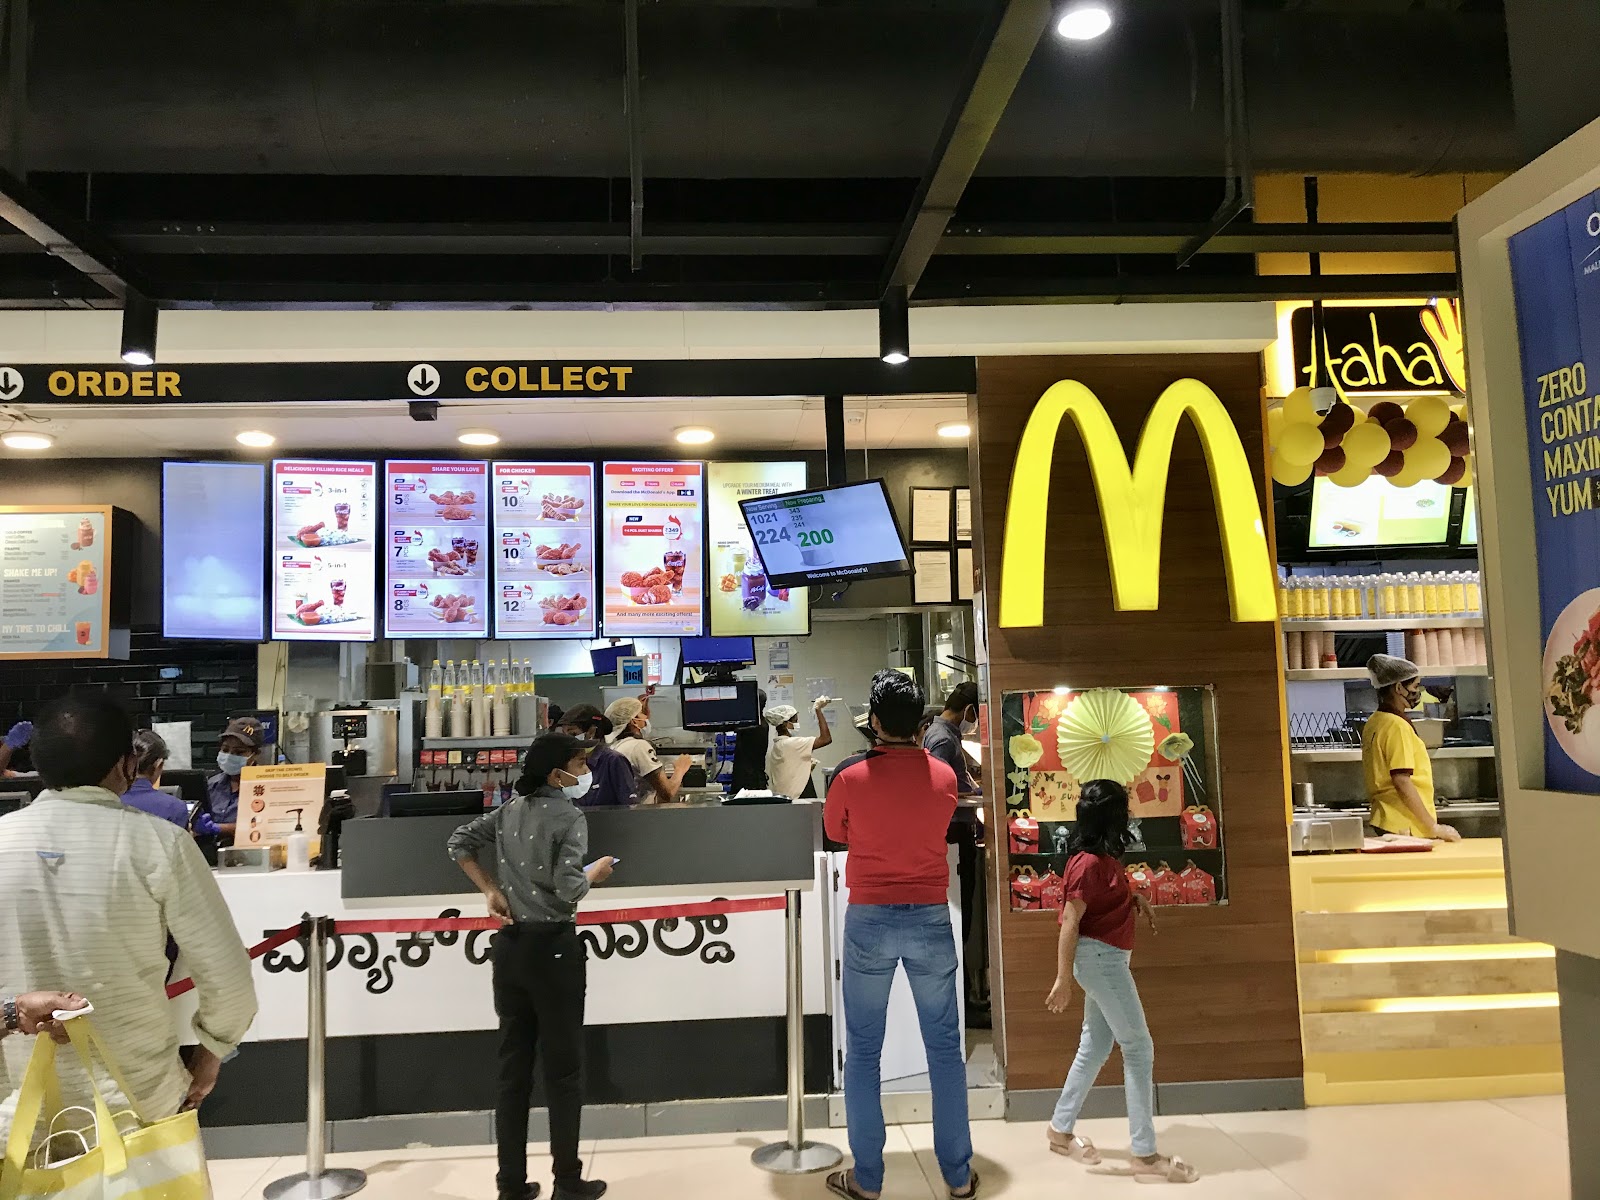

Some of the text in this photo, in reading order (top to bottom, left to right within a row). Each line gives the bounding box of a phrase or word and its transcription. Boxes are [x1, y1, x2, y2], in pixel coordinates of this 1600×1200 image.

[48, 370, 182, 397] ORDER
[465, 366, 633, 392] COLLECT
[1537, 362, 1586, 408] ZERO
[395, 494, 403, 504] 5
[502, 496, 518, 507] 10
[797, 496, 822, 505] Preparing
[1000, 378, 1278, 628] M
[1546, 478, 1592, 518] YUM
[751, 513, 778, 524] 1021
[755, 527, 791, 545] 224
[797, 529, 833, 547] 200
[394, 546, 402, 557] 7
[503, 548, 519, 558] 10
[4, 568, 57, 577] SHAKE ME UP!
[836, 567, 868, 576] McDonald's!
[394, 600, 403, 610] 8
[504, 601, 519, 611] 12
[2, 625, 13, 633] MY
